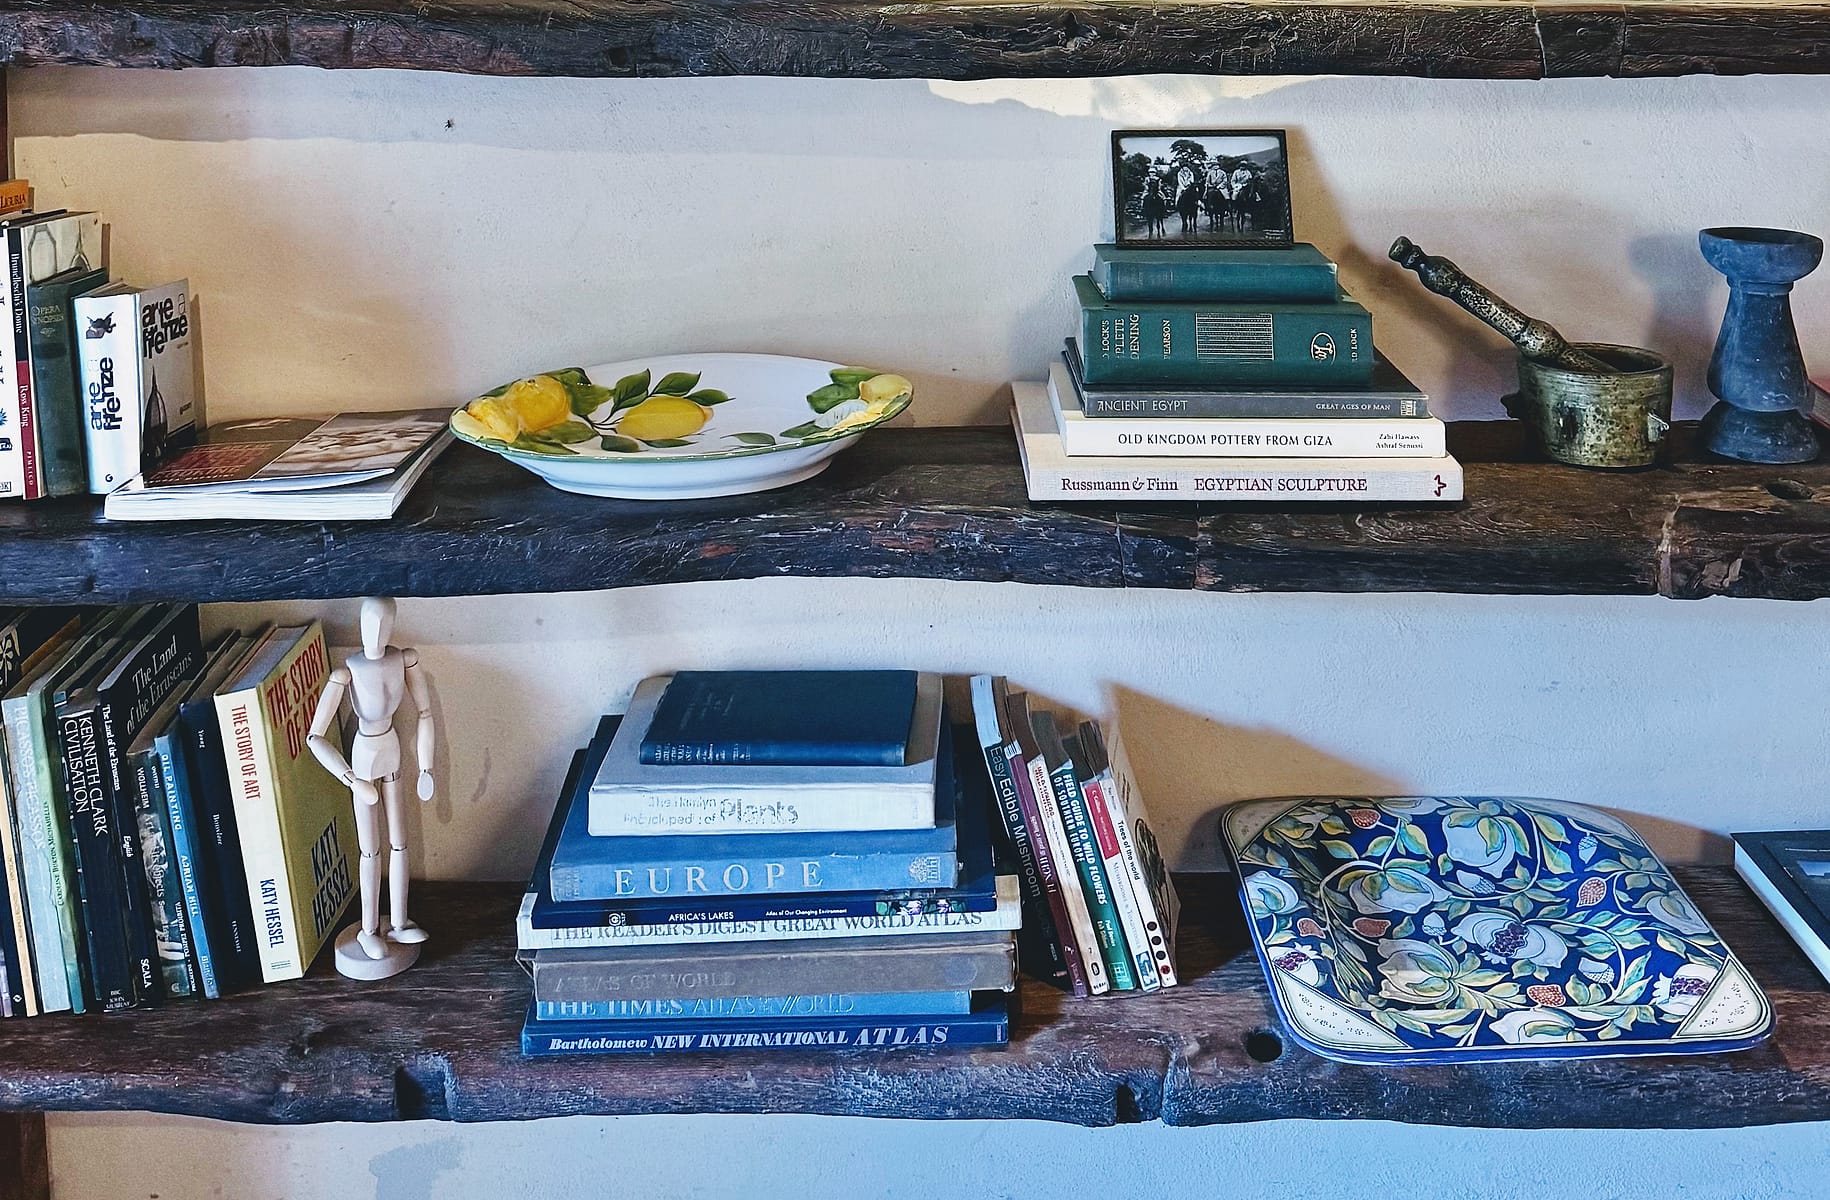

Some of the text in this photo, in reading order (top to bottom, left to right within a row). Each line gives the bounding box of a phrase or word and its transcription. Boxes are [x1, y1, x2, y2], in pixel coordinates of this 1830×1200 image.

[15, 308, 23, 334] Dome
[1101, 320, 1110, 351] LOCK'S
[1114, 318, 1125, 358] PLETE
[1350, 328, 1358, 350] LOCK
[20, 384, 31, 428] Ross King
[1097, 399, 1188, 412] ANCIENT EGYPT
[1315, 403, 1391, 411] GREAT AGES OF MAN
[1118, 433, 1333, 447] OLD KINGDOM POTTERY FROM GIZA
[1061, 476, 1179, 491] Russmann & Finn
[1194, 478, 1368, 492] EGYPTIAN SCULPTURE
[132, 634, 177, 695] The Land
[126, 651, 193, 736] of the Etruscans
[265, 634, 325, 729] THE STORY
[102, 703, 111, 719] The
[104, 720, 114, 738] Land
[286, 711, 302, 761] OF
[64, 719, 90, 813] CIVILISATION
[231, 704, 261, 800] THE STORY OF ART
[78, 716, 108, 837] KENNETH CLARK
[137, 766, 150, 809] WOLLHEIM
[161, 754, 182, 831] OIL PAINTING
[1054, 777, 1063, 790] OF
[720, 797, 799, 825] Plants
[991, 746, 1041, 898] Easy Edible Mushroom
[1058, 790, 1076, 831] SOUTHERN
[311, 816, 340, 887] KATY
[1062, 773, 1108, 906] FIELD GUIDE TO WILD FLOWERS
[1070, 833, 1085, 863] EUROPE
[1118, 819, 1127, 841] Trees
[1130, 861, 1141, 881] world
[181, 855, 198, 917] ADRIAN HILL
[260, 878, 279, 905] KATY
[613, 860, 825, 896] EUROPE
[312, 853, 353, 939] HESSEL
[795, 908, 818, 917] Changing
[265, 907, 284, 949] HESSEL
[552, 910, 983, 941] THE READER'S DIGEST GREAT WORLD ATLAS
[668, 911, 734, 922] AFRICA'S LAKES
[140, 958, 152, 988] SCALA
[547, 1000, 596, 1016] THE
[602, 998, 684, 1016] TIMES
[549, 1025, 950, 1051] Bartholomew NEW INTERNATIONAL ATLAS
